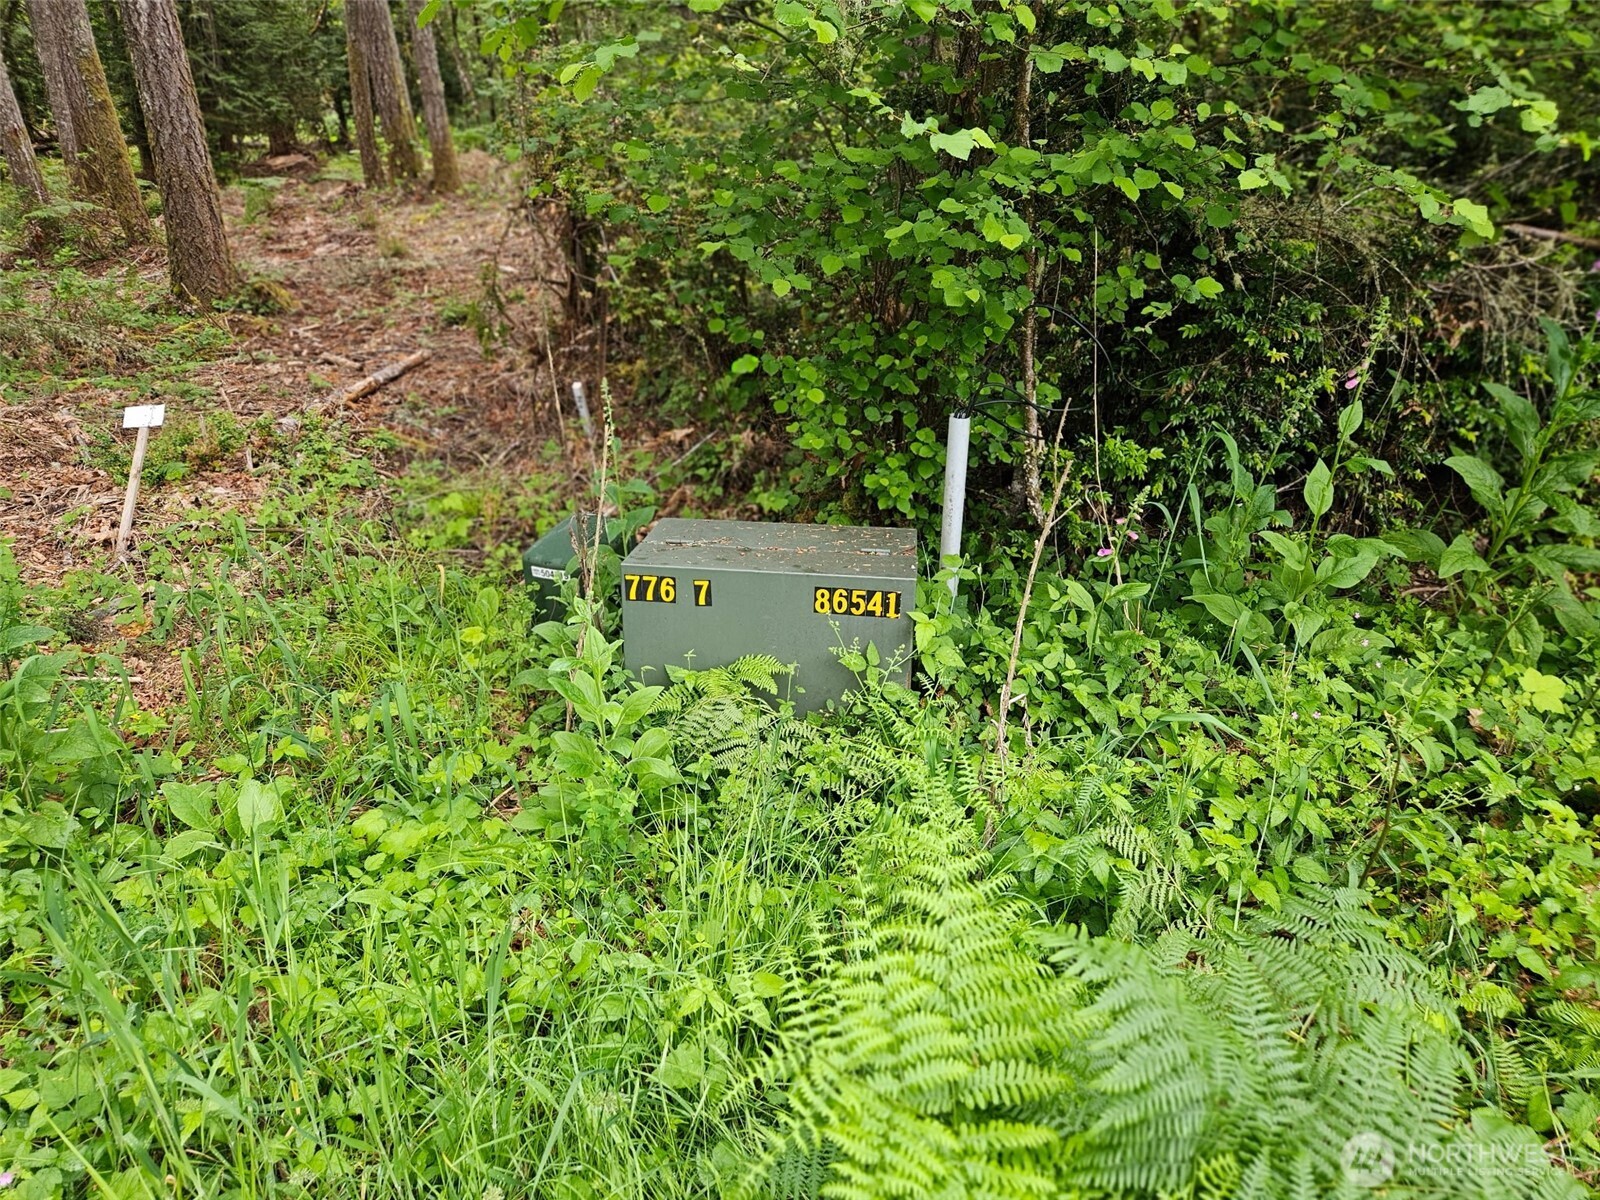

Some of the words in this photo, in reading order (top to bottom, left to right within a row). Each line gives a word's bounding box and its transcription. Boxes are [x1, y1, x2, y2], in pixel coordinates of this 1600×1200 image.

[625, 575, 676, 603] 776
[693, 580, 710, 605] 7
[814, 588, 901, 618] 86541
